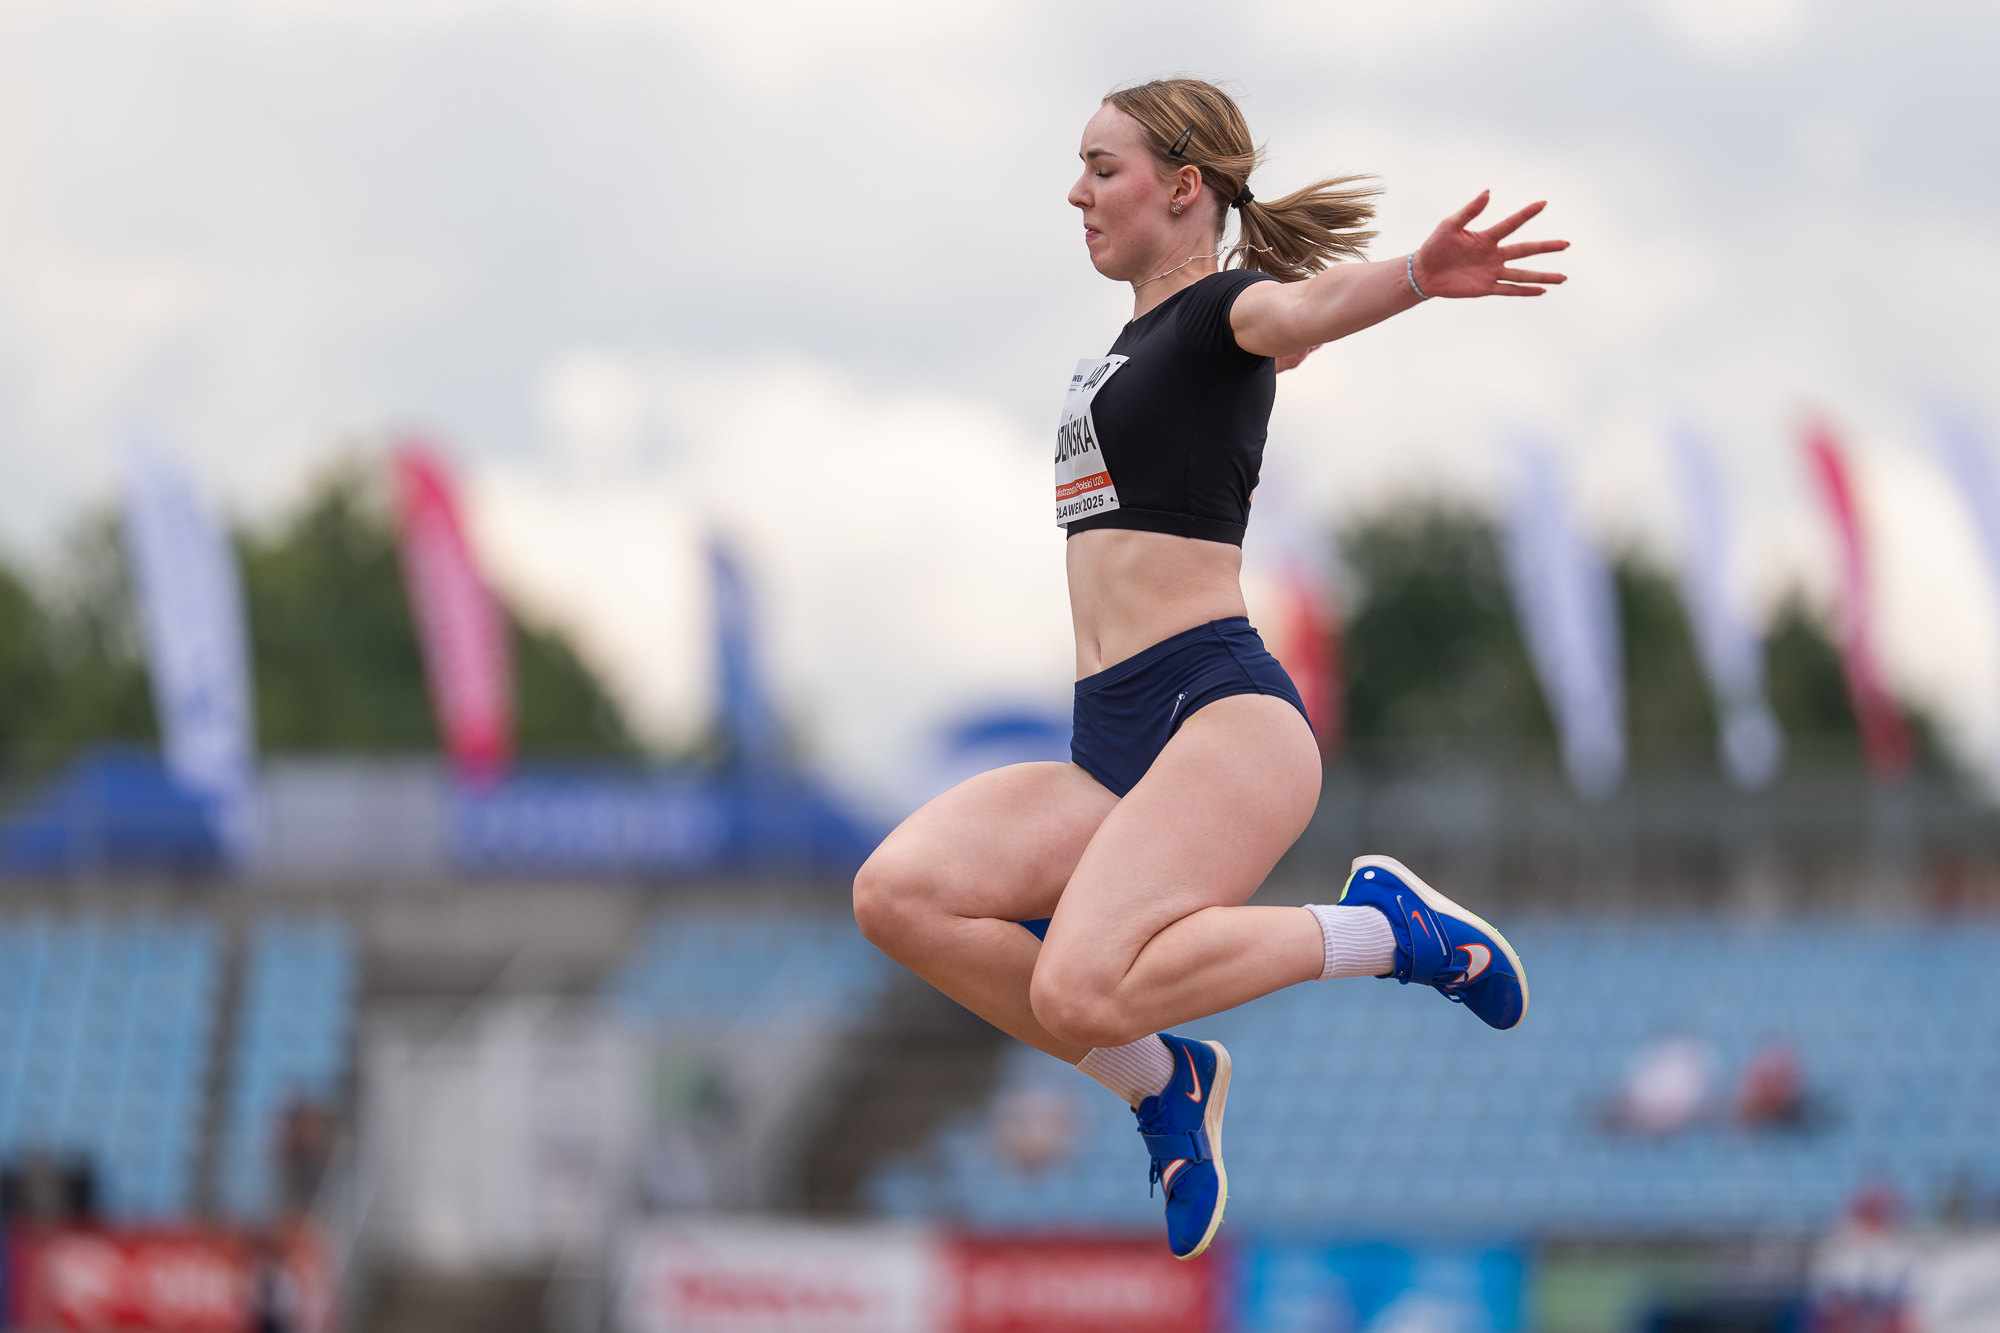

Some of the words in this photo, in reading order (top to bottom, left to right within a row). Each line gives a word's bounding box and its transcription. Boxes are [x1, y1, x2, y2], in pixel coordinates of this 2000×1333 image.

[1076, 478, 1092, 491] Polski
[1093, 475, 1104, 487] U20
[1082, 494, 1104, 512] 2025
